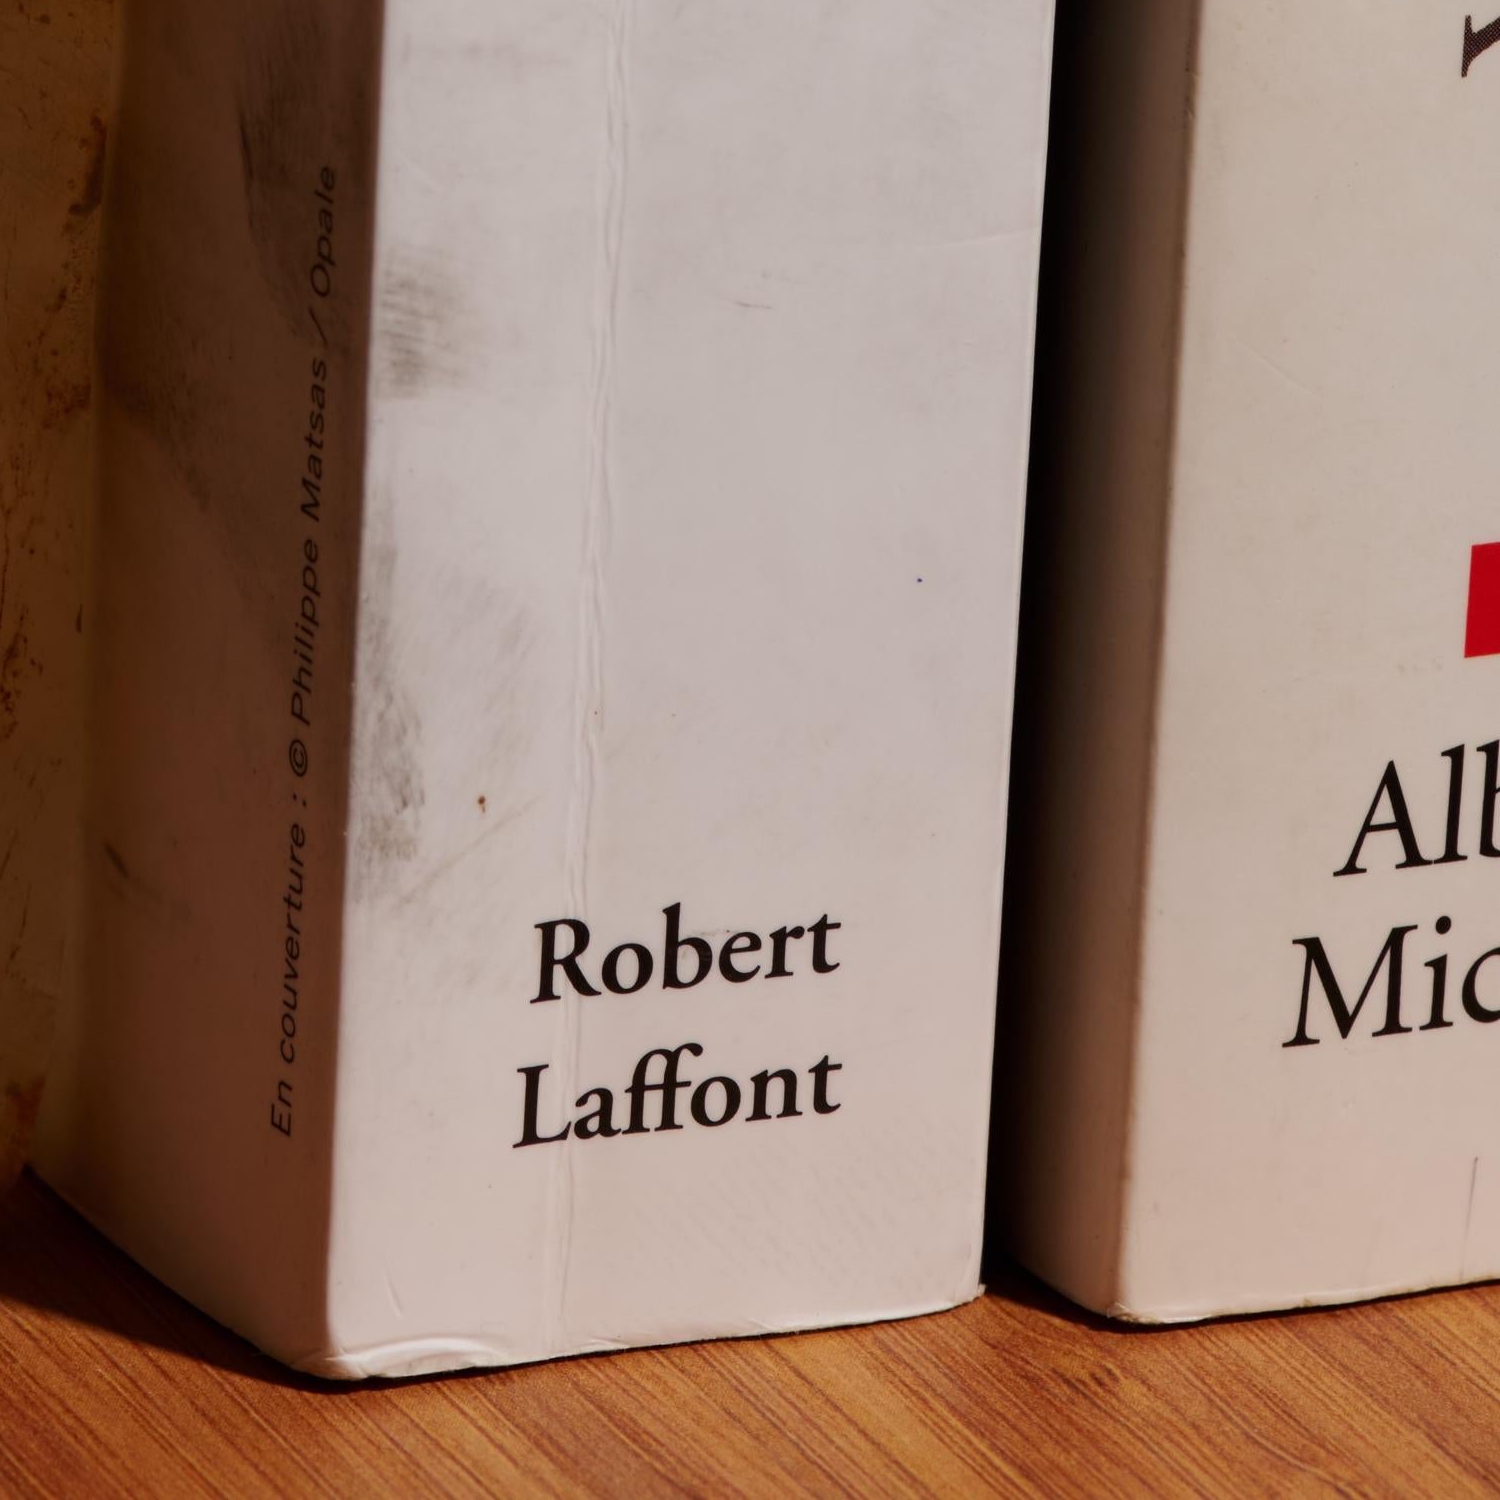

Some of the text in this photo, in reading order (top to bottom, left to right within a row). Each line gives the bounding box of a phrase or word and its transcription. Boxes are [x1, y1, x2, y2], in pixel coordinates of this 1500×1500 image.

[309, 165, 336, 298] Opale
[301, 357, 327, 522] Matsas
[290, 538, 322, 727] Philippe
[279, 823, 306, 1065] couverture
[529, 902, 842, 1004] Robert
[270, 1080, 293, 1138] En
[512, 1042, 843, 1149] Laffont
